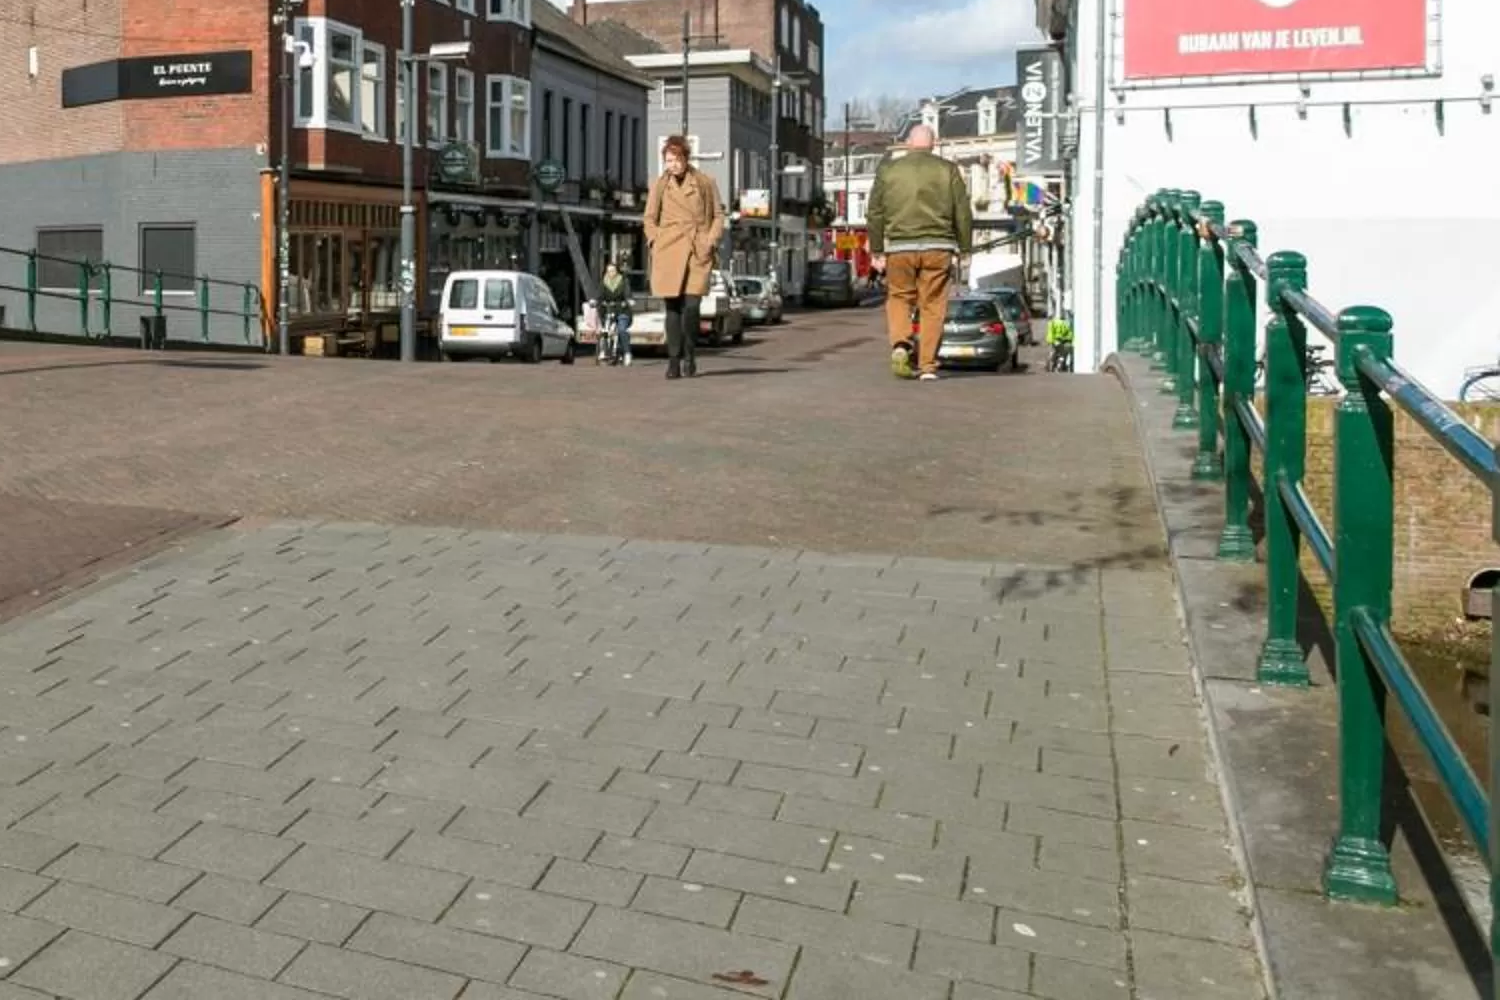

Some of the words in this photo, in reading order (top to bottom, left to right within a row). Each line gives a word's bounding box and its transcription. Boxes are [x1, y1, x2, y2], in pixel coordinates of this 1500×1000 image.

[1241, 30, 1273, 50] VAN
[1275, 29, 1290, 49] JE
[153, 65, 166, 75] EL
[169, 62, 212, 74] PUENTE
